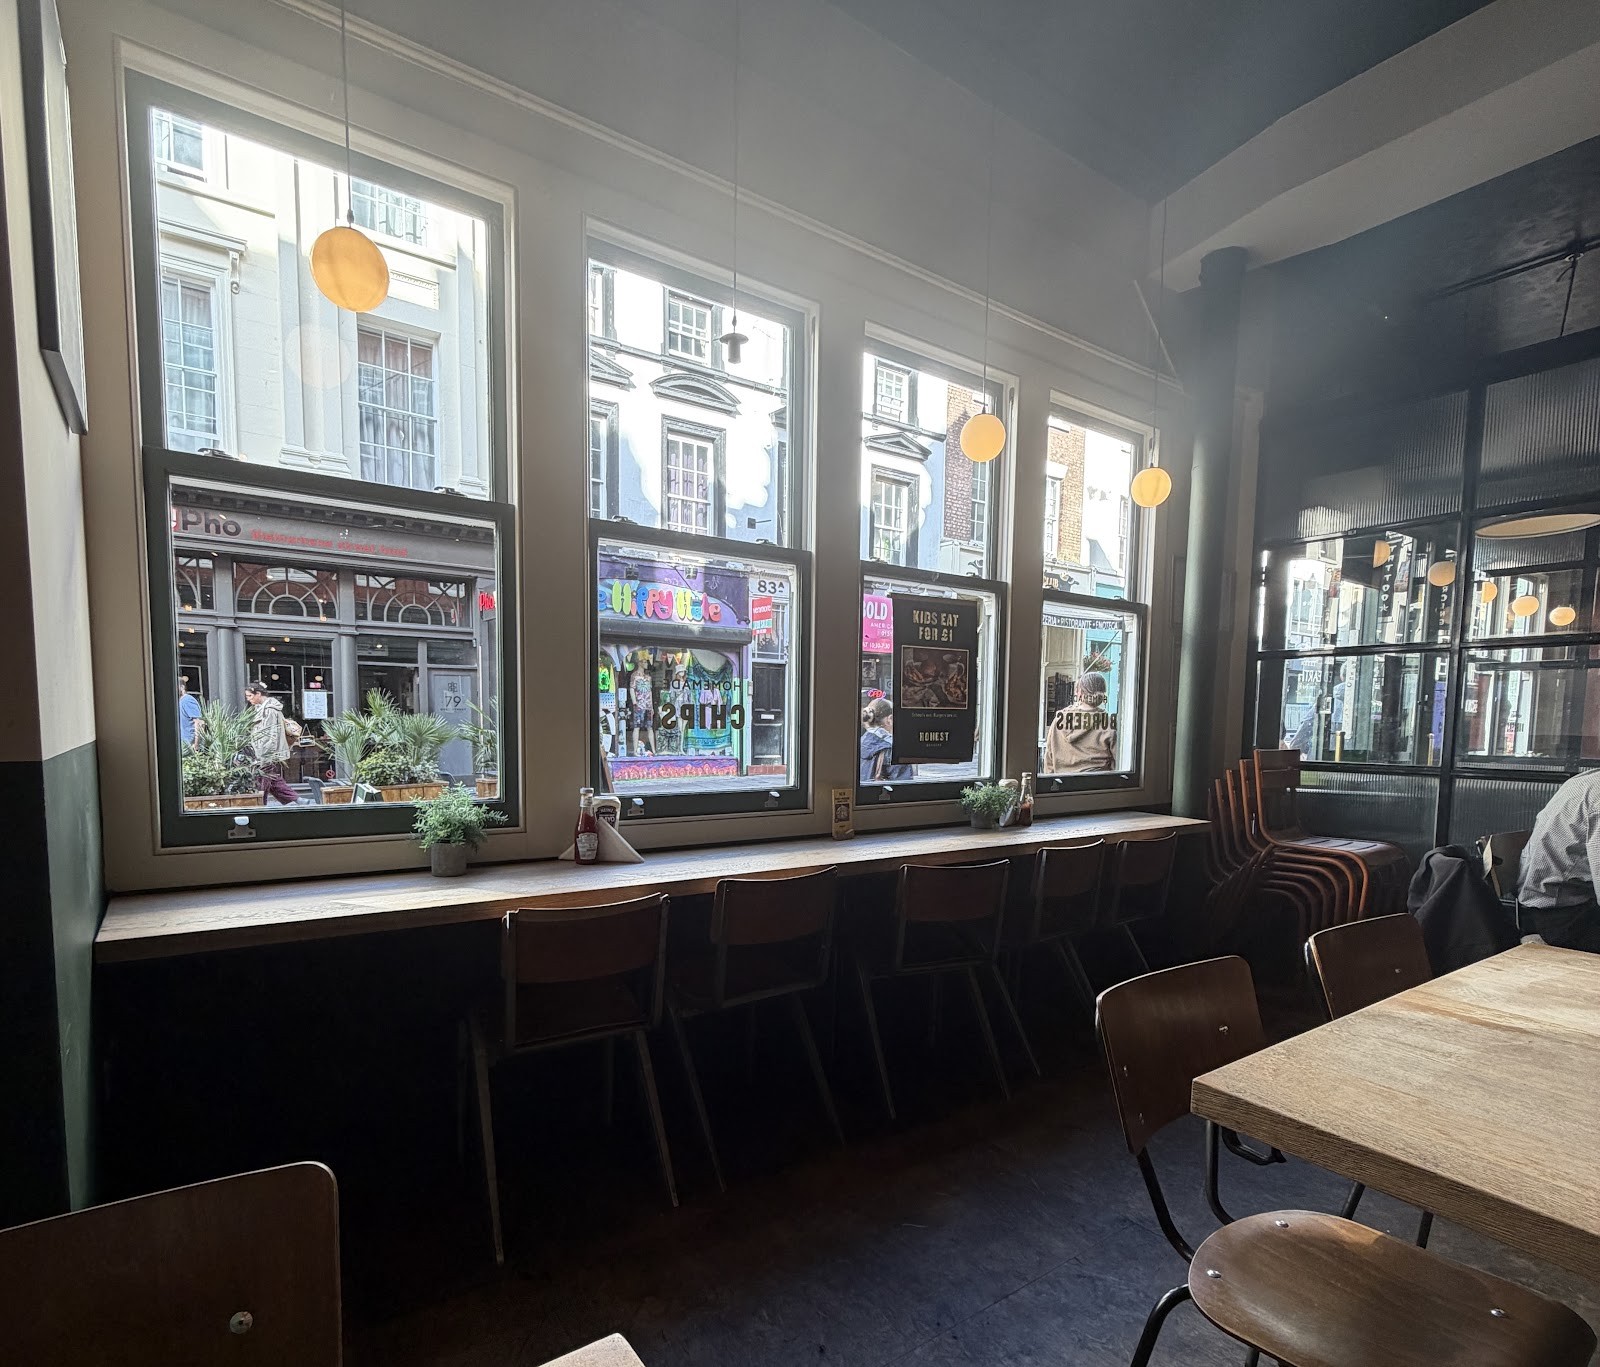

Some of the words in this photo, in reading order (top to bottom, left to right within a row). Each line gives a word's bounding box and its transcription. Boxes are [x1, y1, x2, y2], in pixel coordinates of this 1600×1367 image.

[181, 508, 242, 537] Pho
[611, 580, 673, 620] Hippy
[912, 609, 938, 625] KIDS
[940, 612, 959, 627] EAT
[918, 626, 938, 641] FOR
[940, 628, 953, 642] £1
[444, 696, 462, 708] 79
[919, 731, 950, 742] HONEST
